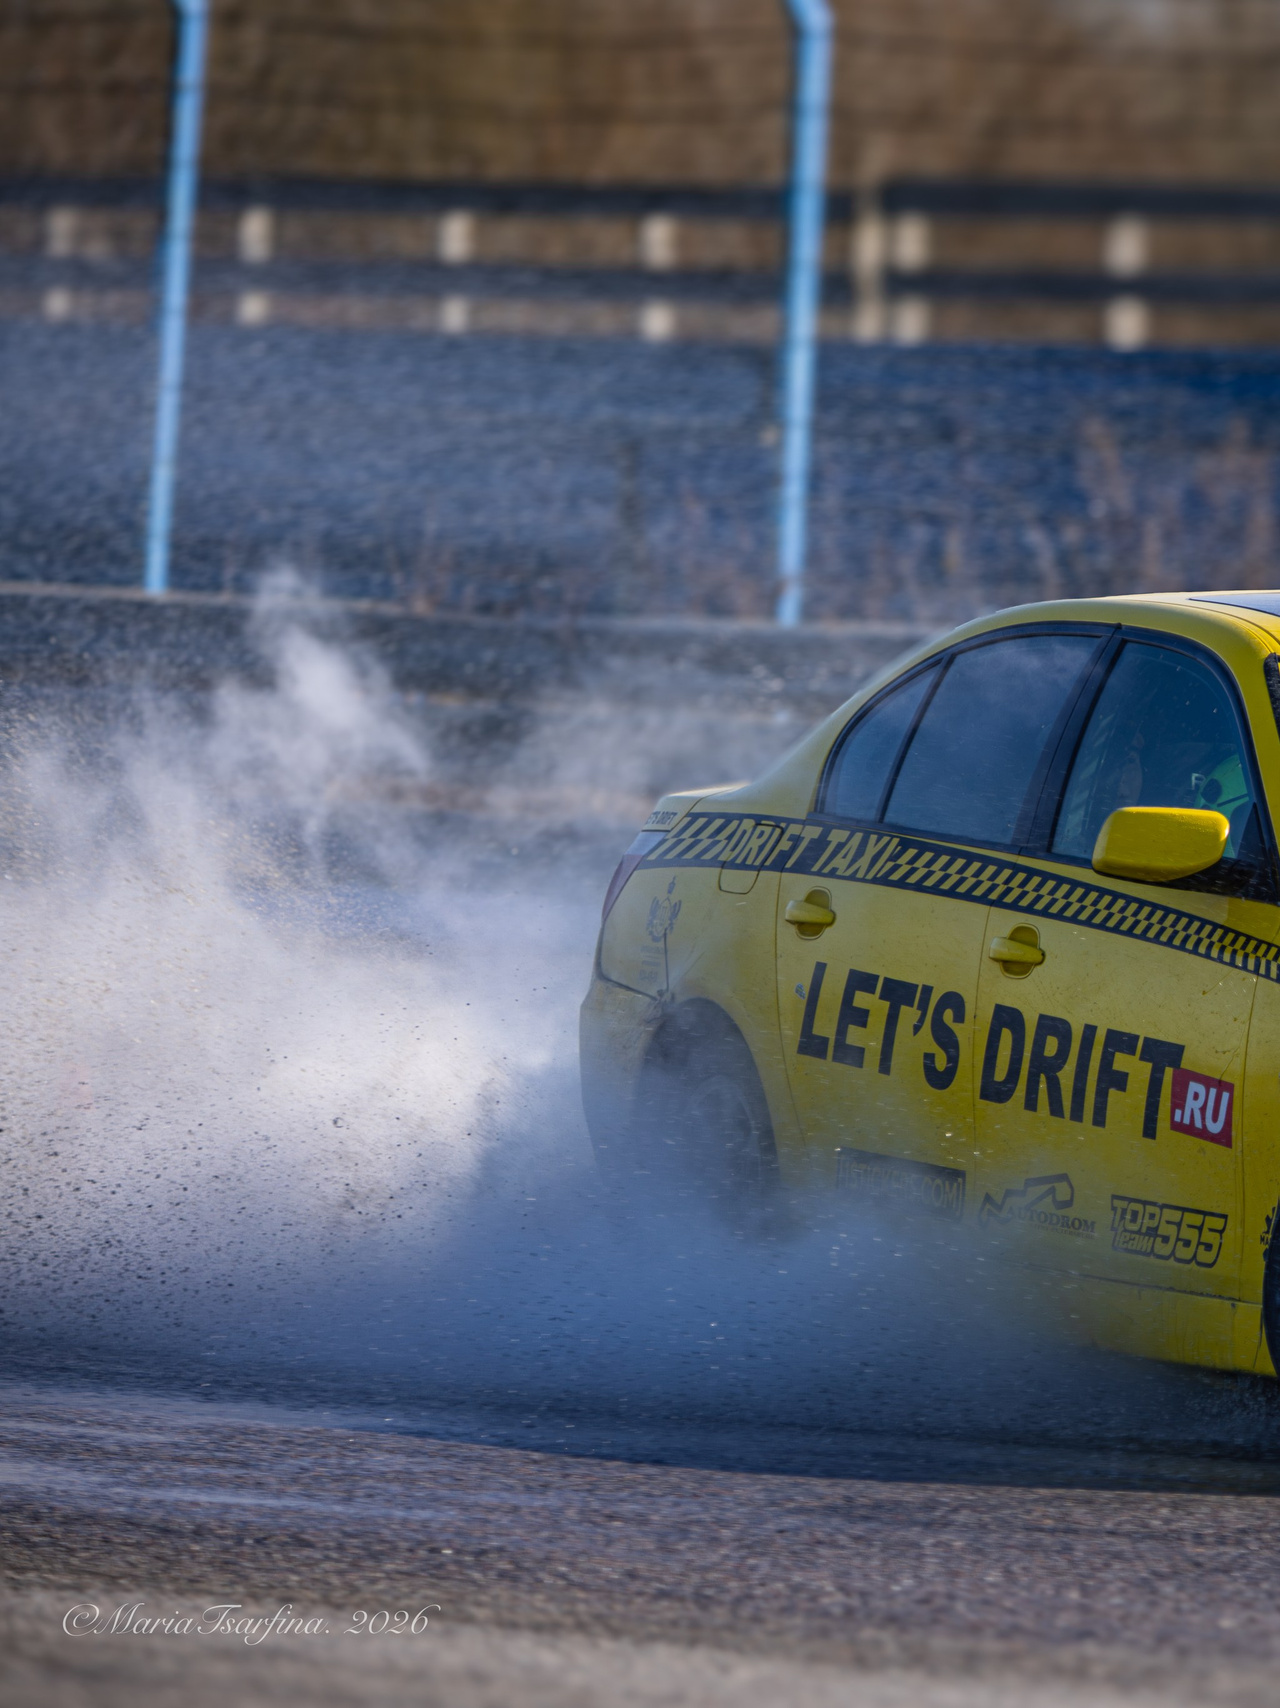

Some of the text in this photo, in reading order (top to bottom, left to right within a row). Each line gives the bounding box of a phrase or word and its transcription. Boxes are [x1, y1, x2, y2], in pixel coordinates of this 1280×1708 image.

[722, 818, 900, 880] DRIFT TAXI
[1112, 1199, 1226, 1266] TOP 555
